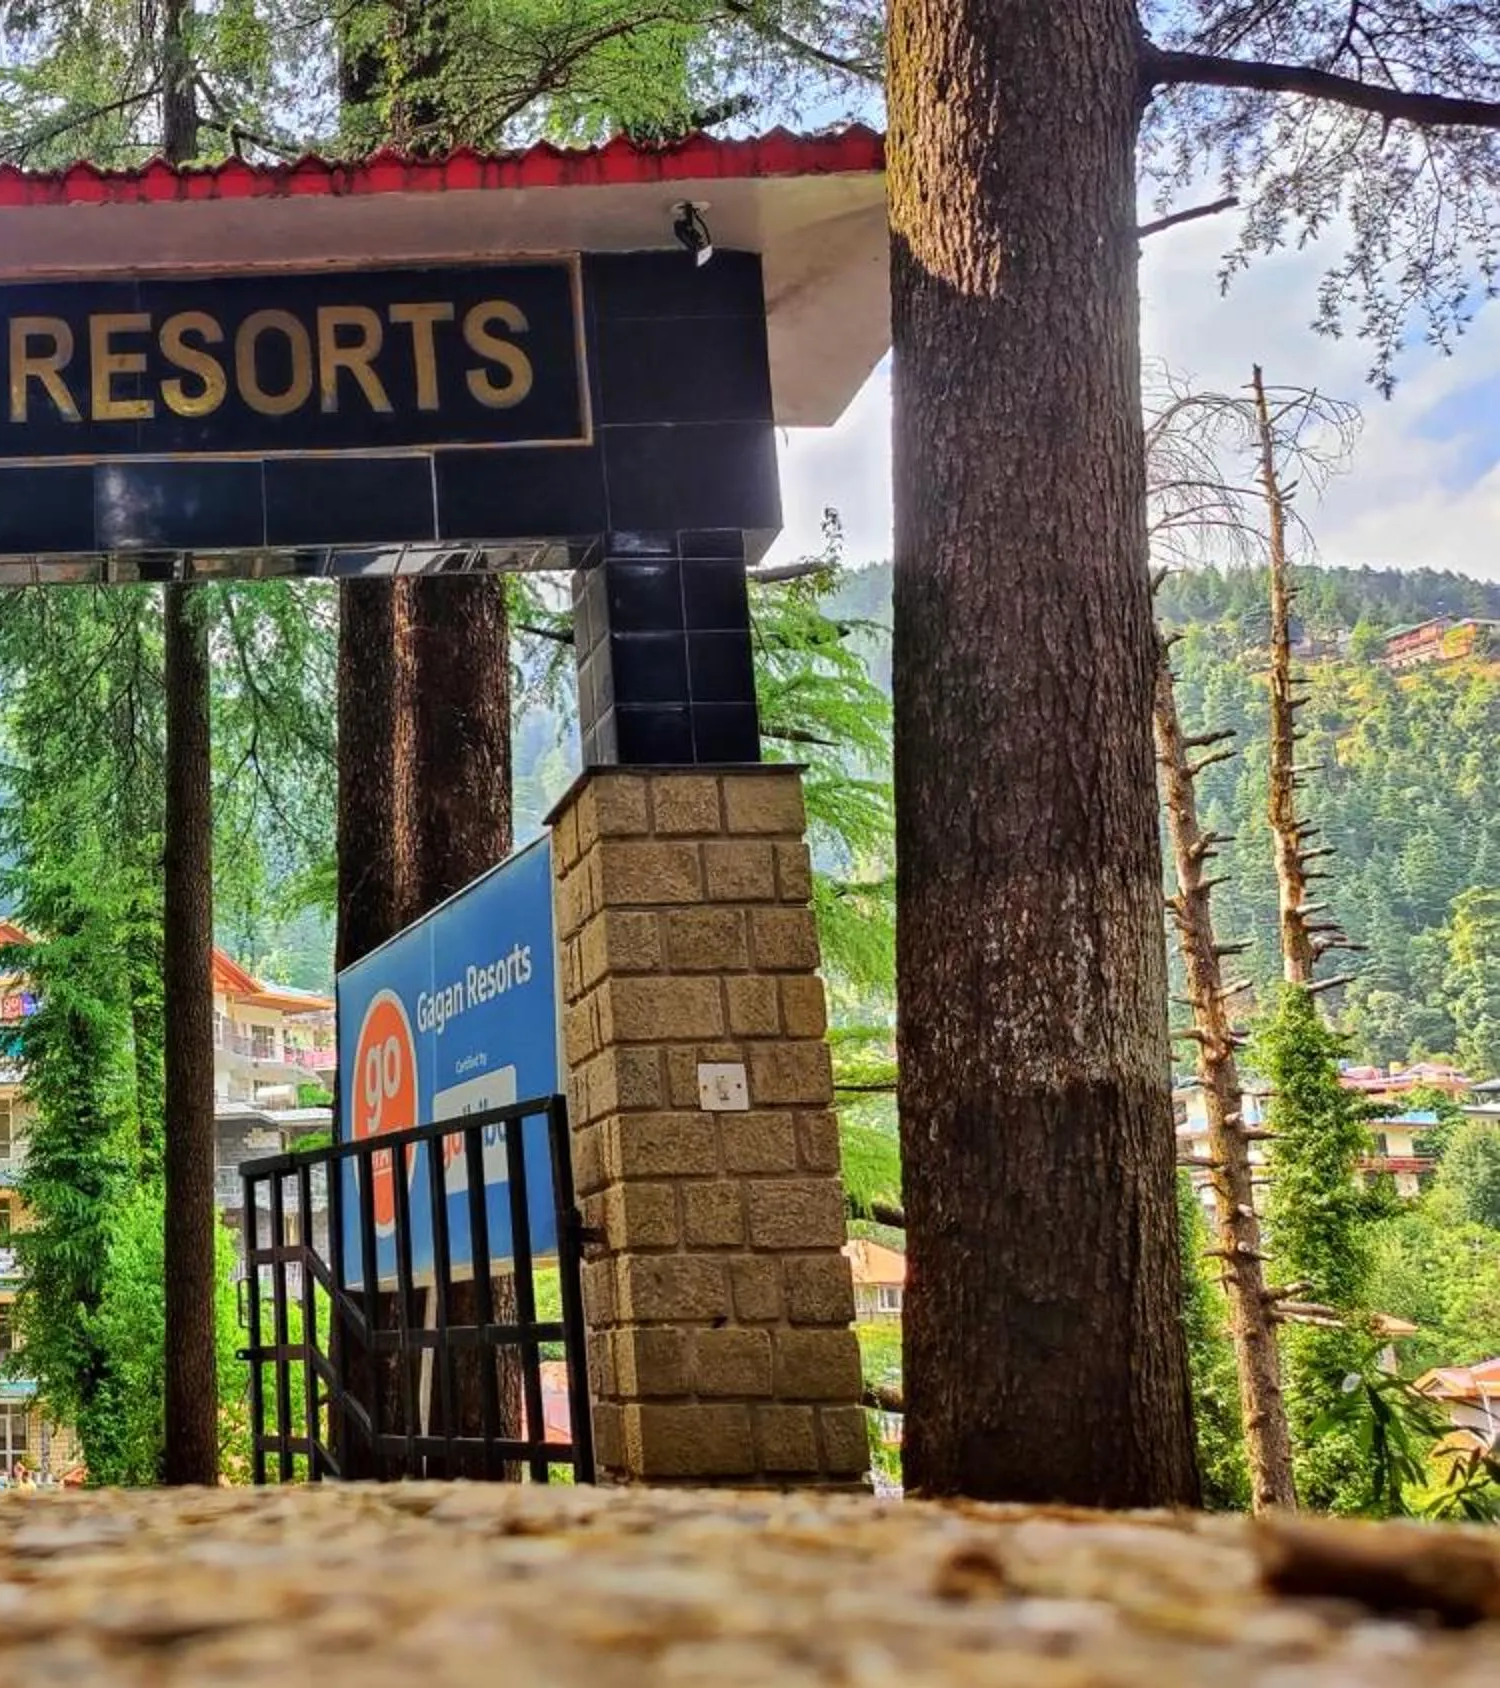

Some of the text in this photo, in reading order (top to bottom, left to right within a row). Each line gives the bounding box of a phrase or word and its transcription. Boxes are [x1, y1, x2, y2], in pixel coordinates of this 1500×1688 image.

[8, 299, 534, 423] RESORTS
[417, 943, 533, 1035] Gagan Resorts
[364, 1035, 402, 1137] go
